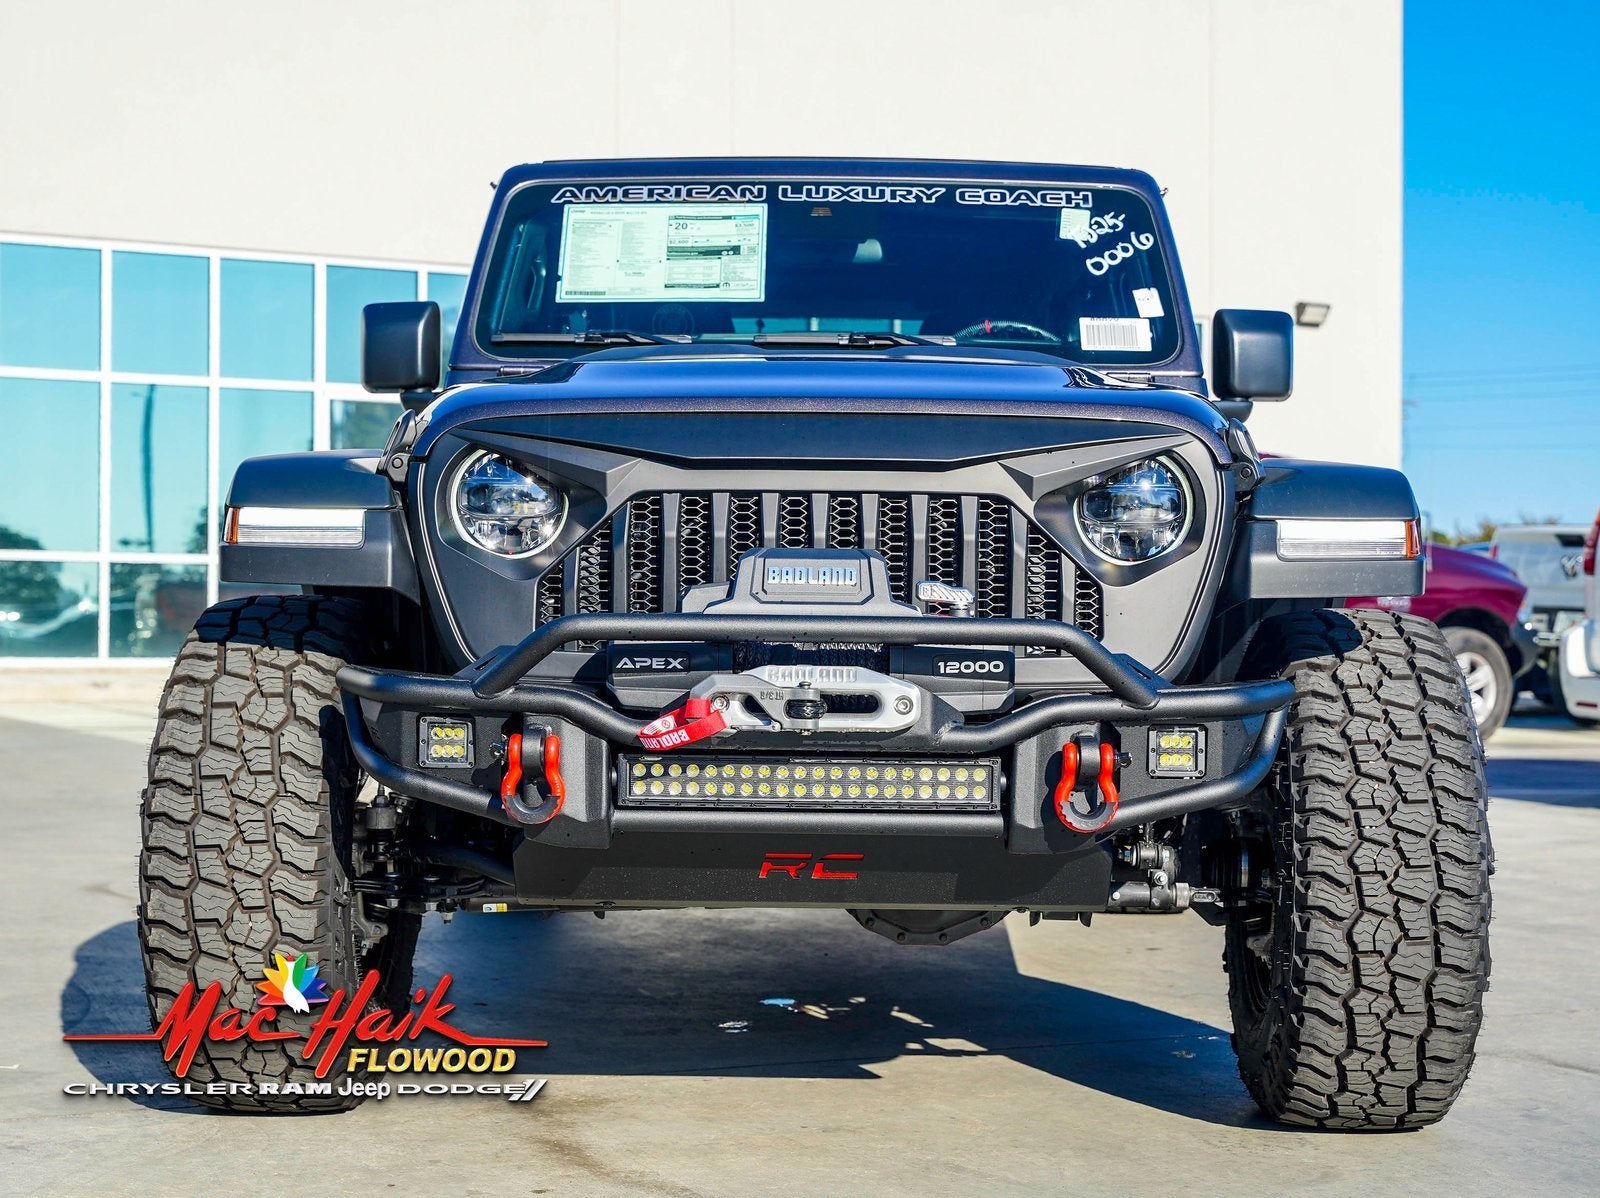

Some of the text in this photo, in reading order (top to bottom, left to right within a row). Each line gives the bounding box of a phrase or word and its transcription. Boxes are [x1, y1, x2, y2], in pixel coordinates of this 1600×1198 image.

[551, 185, 1093, 207] AMERICAN LUXURY COACH
[674, 222, 688, 230] 20
[1086, 231, 1154, 276] 0006
[767, 565, 858, 587] BADLAND
[615, 657, 684, 670] APEX
[937, 659, 1004, 674] 12000
[767, 666, 858, 683] BADLAND
[759, 853, 864, 879] RC
